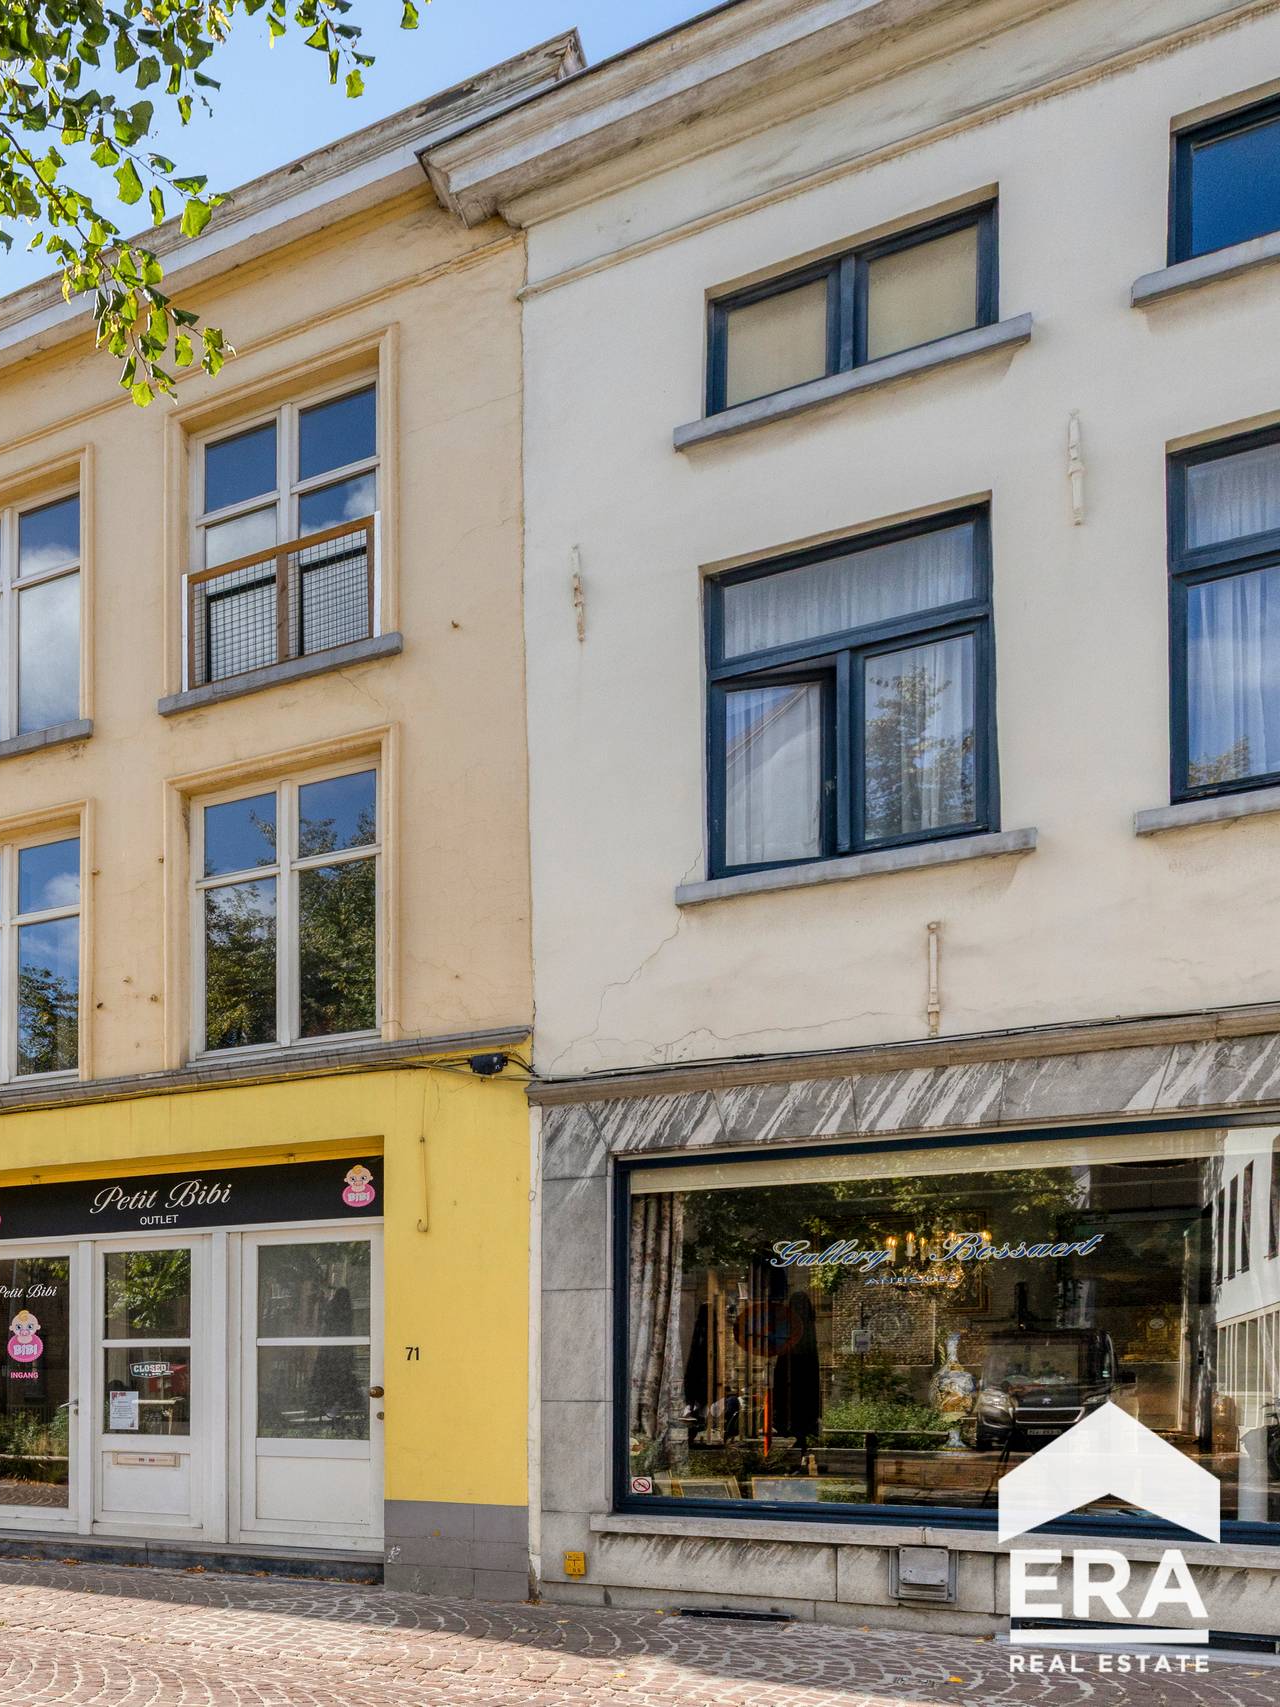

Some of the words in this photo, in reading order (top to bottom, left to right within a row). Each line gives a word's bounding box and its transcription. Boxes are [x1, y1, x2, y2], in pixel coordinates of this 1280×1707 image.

[89, 1185, 159, 1215] Petit
[165, 1179, 233, 1208] Bibi
[140, 1214, 179, 1226] OUTLET
[770, 1239, 892, 1273] Gallery
[928, 1232, 1105, 1263] Bossaert
[26, 1283, 58, 1299] Bibi
[13, 1344, 38, 1356] BIBI
[405, 1346, 420, 1361] 71
[10, 1371, 39, 1379] INGANG
[133, 1364, 167, 1373] CLOSED
